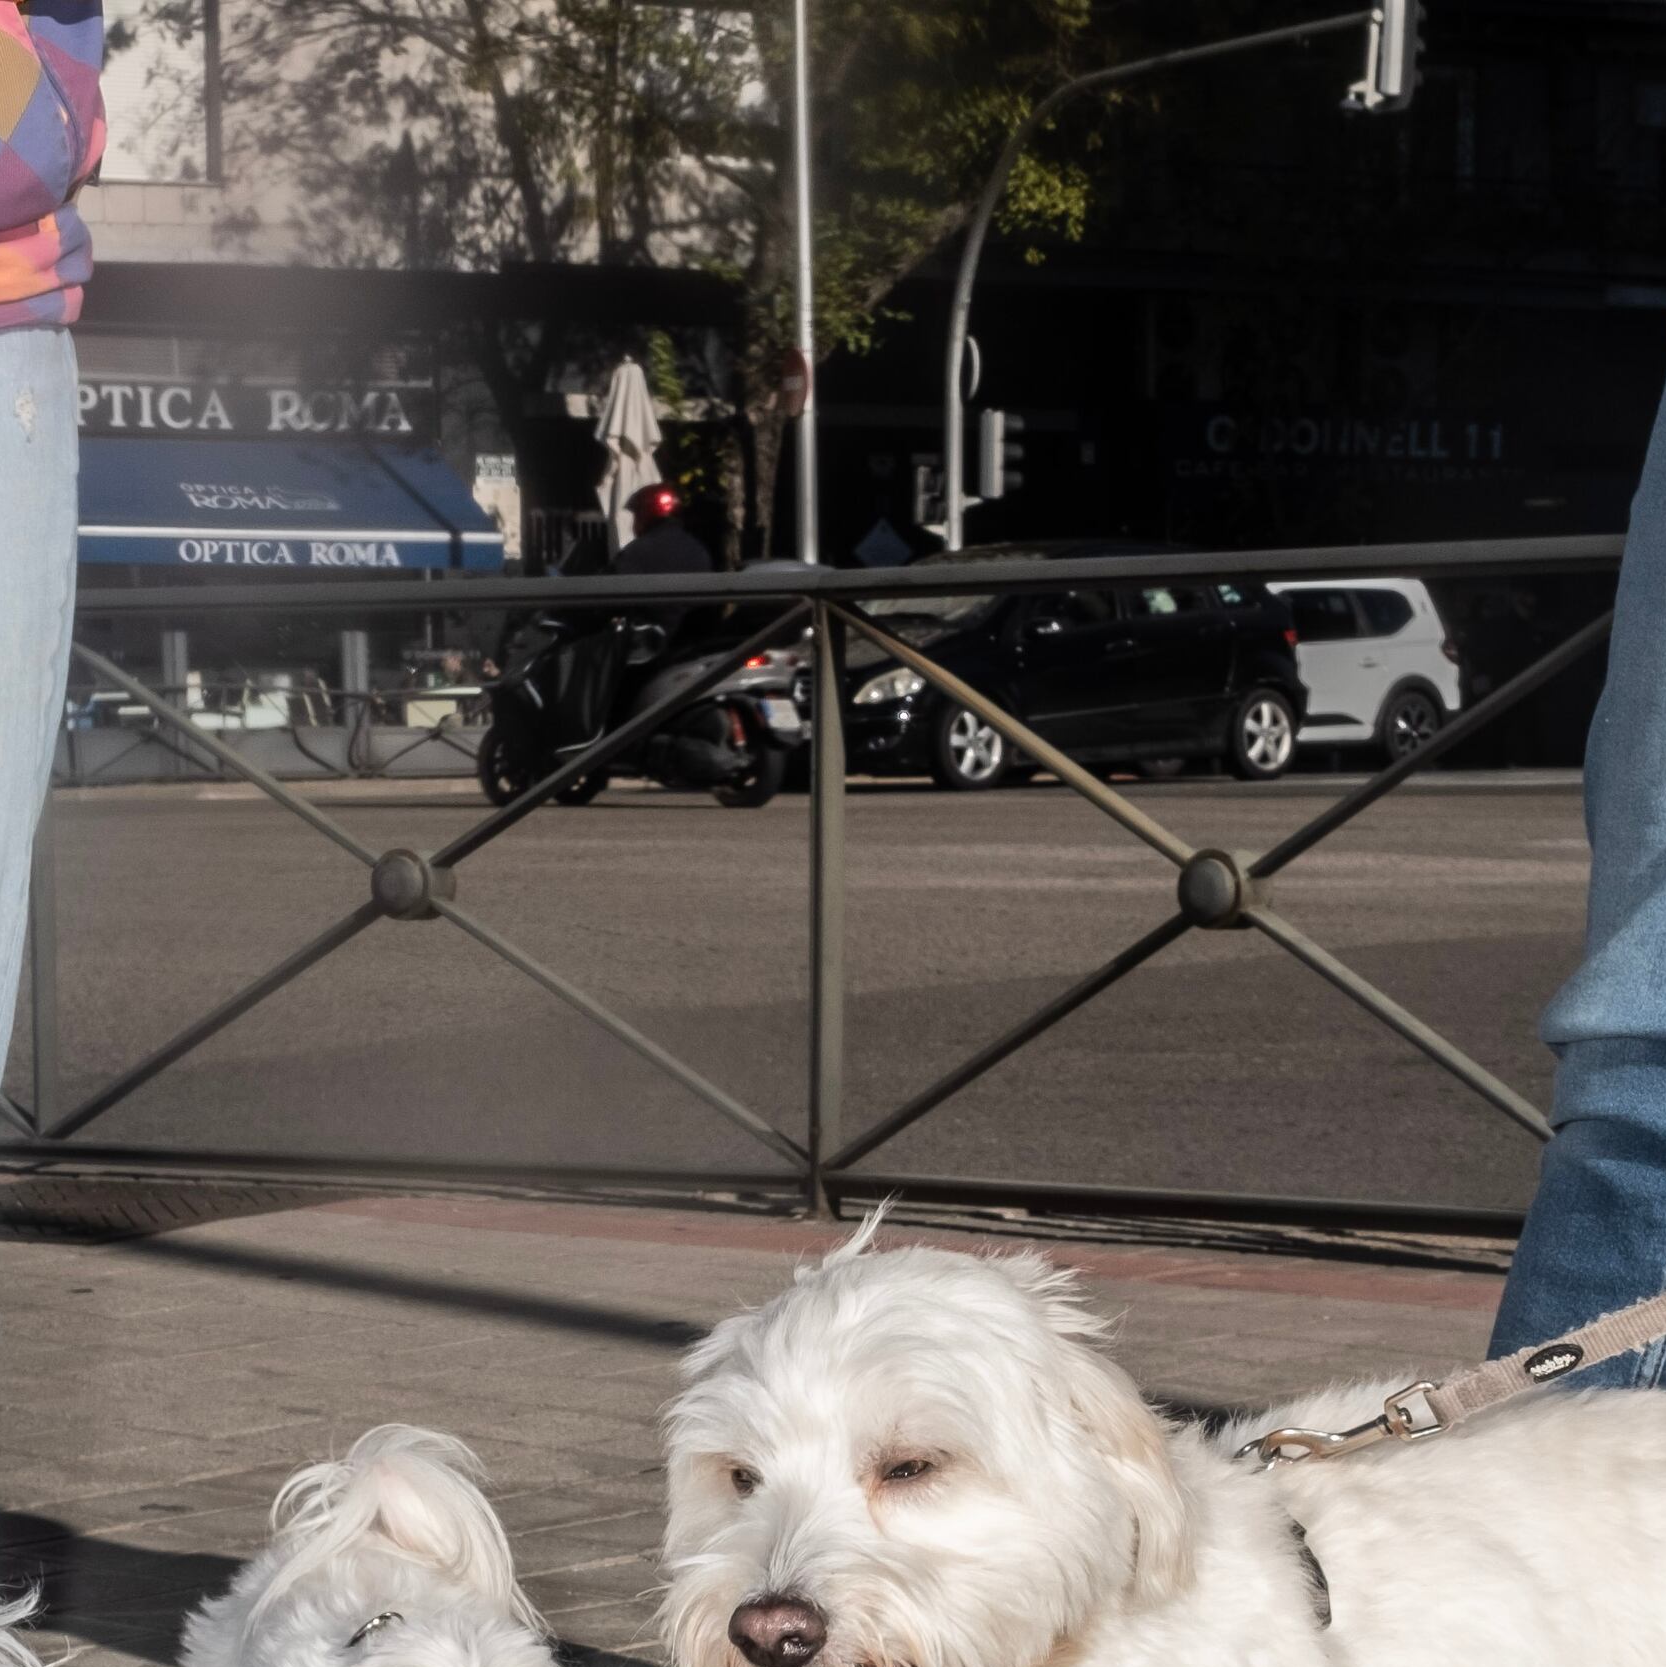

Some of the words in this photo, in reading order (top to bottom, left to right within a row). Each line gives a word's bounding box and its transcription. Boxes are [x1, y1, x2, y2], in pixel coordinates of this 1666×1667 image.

[77, 384, 234, 430] PTICA
[267, 388, 413, 432] ROMA
[1466, 422, 1505, 460] 11
[186, 494, 289, 510] ROMA
[178, 539, 297, 565] OPTICA
[308, 541, 402, 567] ROMA
